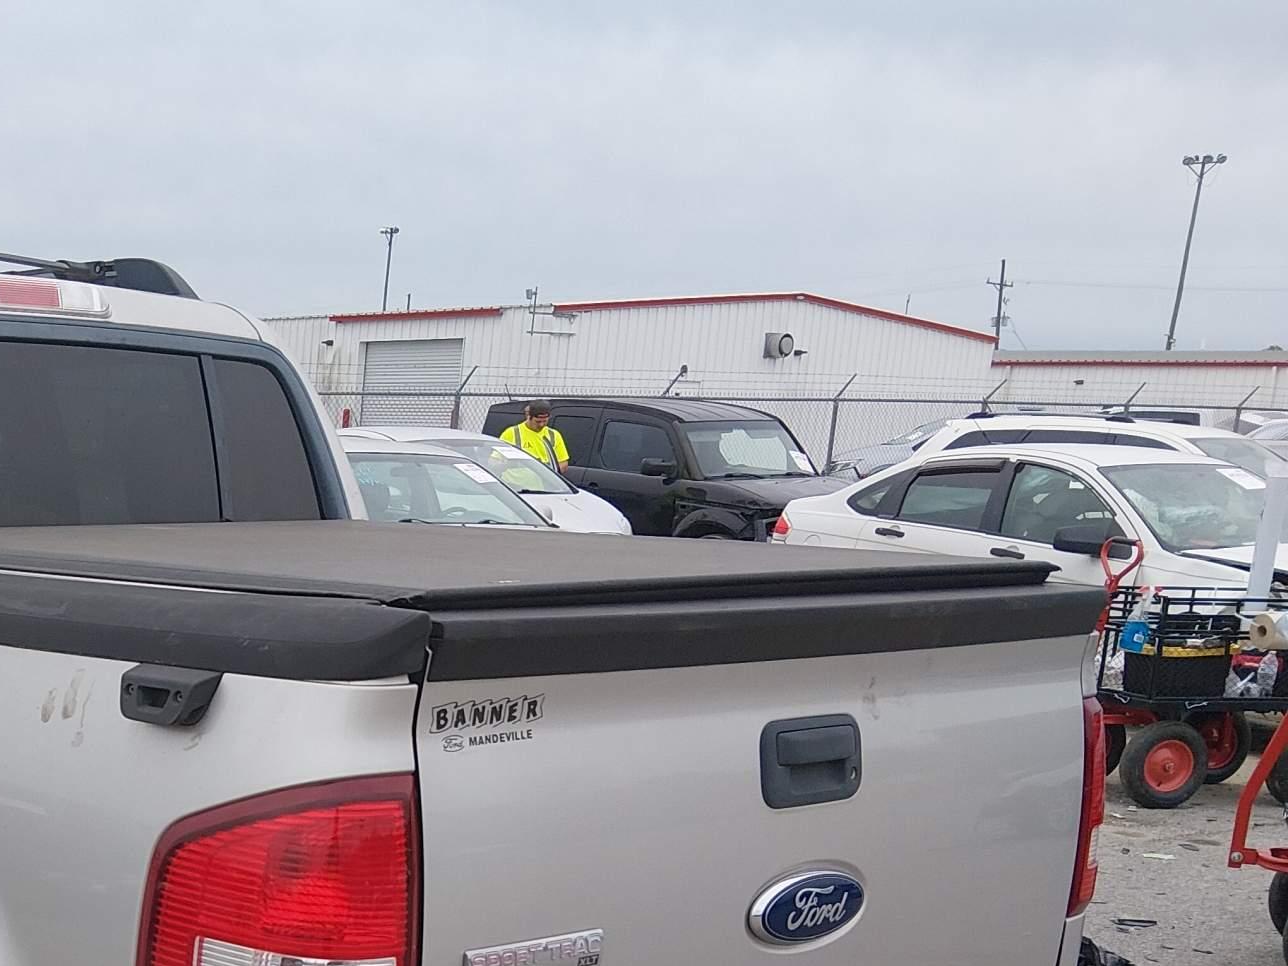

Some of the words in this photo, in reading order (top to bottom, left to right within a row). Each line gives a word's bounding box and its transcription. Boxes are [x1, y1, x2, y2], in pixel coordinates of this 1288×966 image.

[434, 698, 540, 731] BANNER
[468, 729, 533, 747] MANDEVILLE
[787, 885, 849, 930] Ford
[545, 932, 602, 962] TRAC
